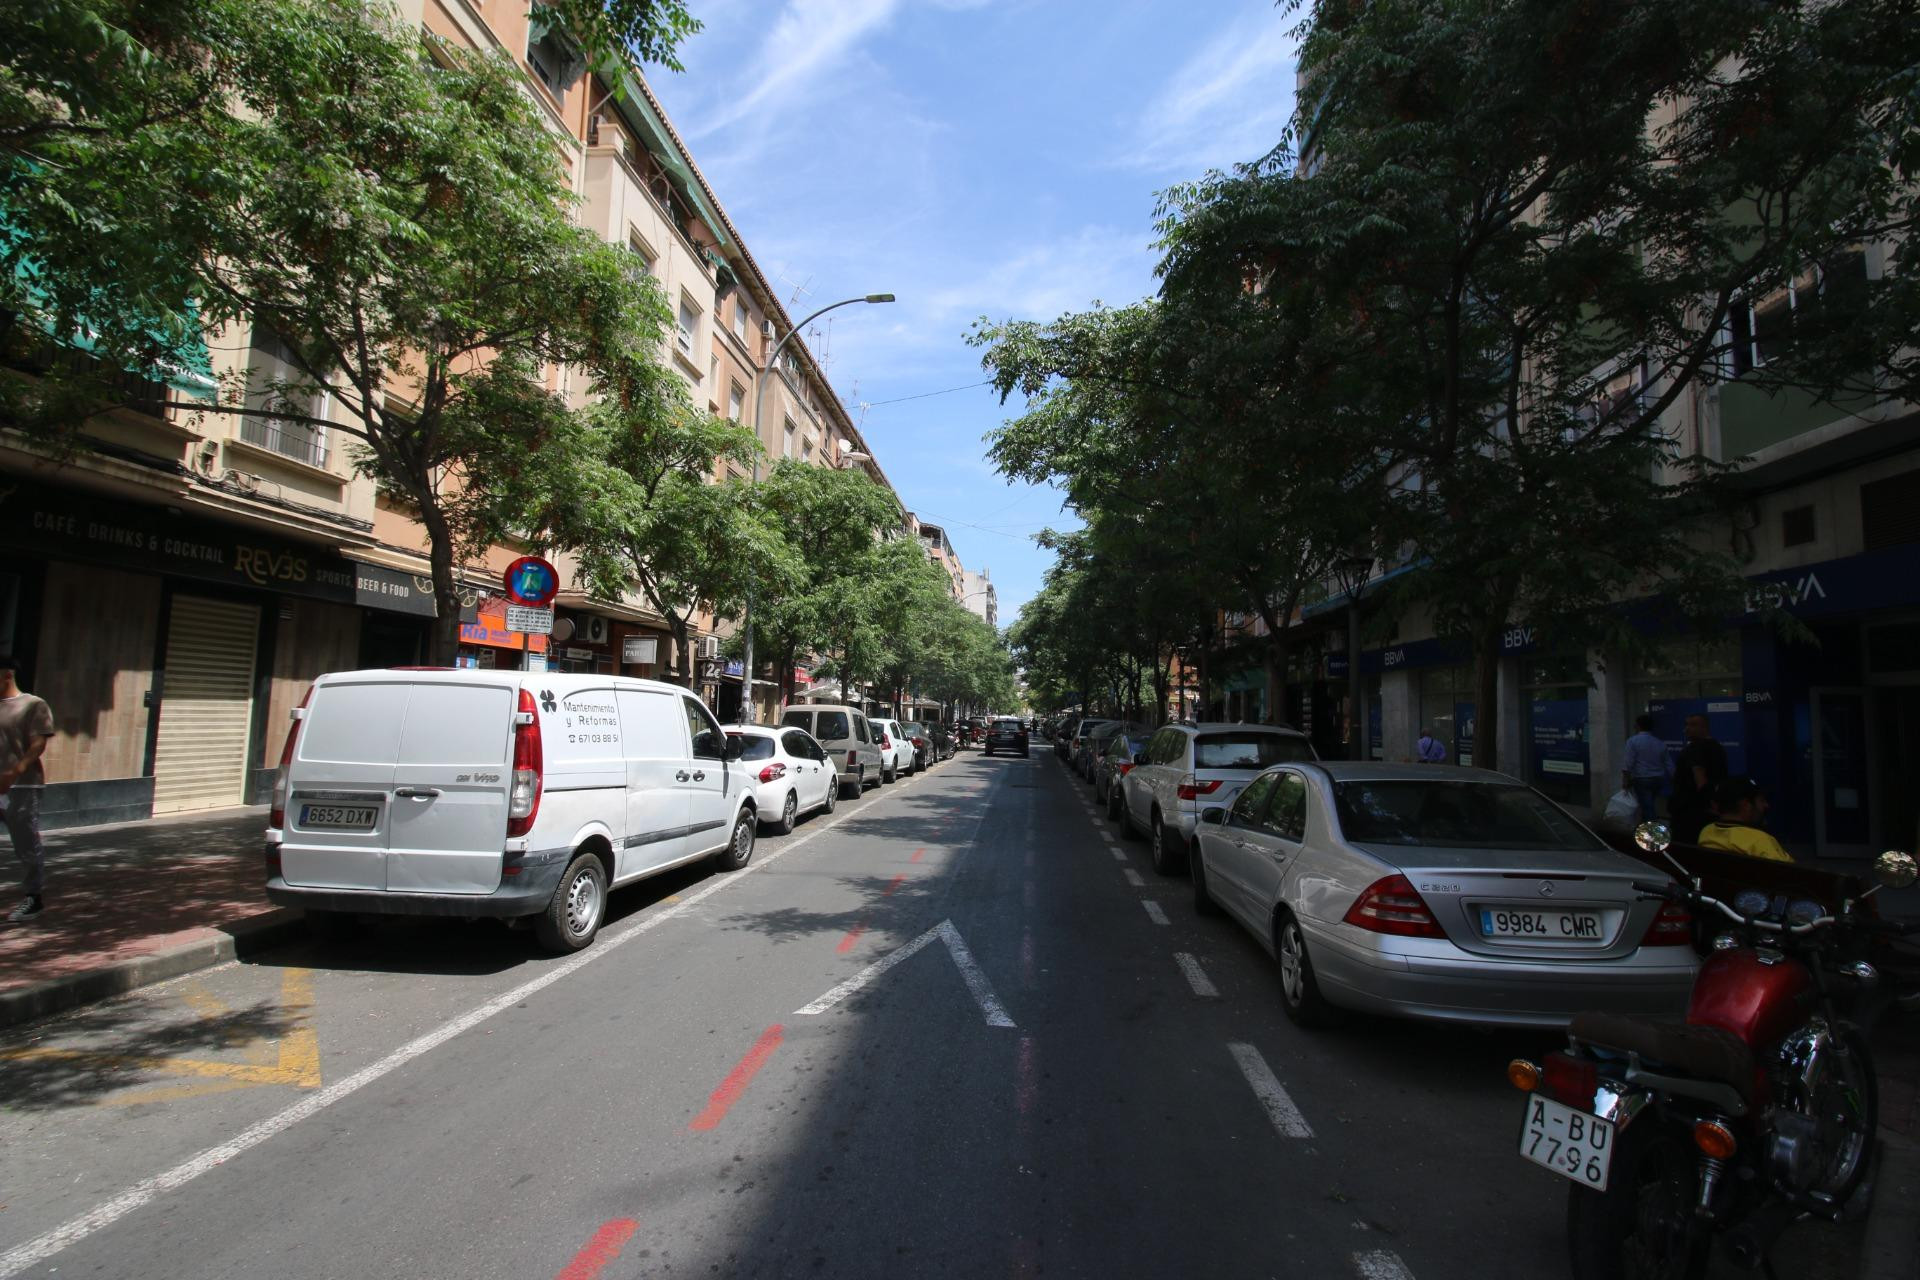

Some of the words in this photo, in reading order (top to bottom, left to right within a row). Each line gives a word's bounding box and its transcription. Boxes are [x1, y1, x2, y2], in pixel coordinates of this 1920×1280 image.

[88, 522, 143, 549] DRINKS
[149, 536, 158, 550] &
[164, 538, 224, 563] COCKTAIL
[357, 577, 379, 592] BEER
[382, 582, 387, 594] &
[390, 584, 409, 598] FOOD
[1504, 626, 1535, 649] BBV
[1384, 649, 1406, 666] BBVA
[1745, 691, 1772, 702] BBVA
[563, 701, 615, 713] Mantenimiento
[566, 717, 571, 727] y
[578, 715, 617, 726] Reformas
[578, 734, 590, 742] 671
[592, 734, 601, 742] 03
[310, 808, 343, 824] 6652
[346, 809, 374, 825] DXW
[1497, 912, 1546, 935] 9984
[1560, 914, 1598, 937] CMR
[1531, 1100, 1607, 1151] A-BU
[1530, 1129, 1602, 1182] 7796
